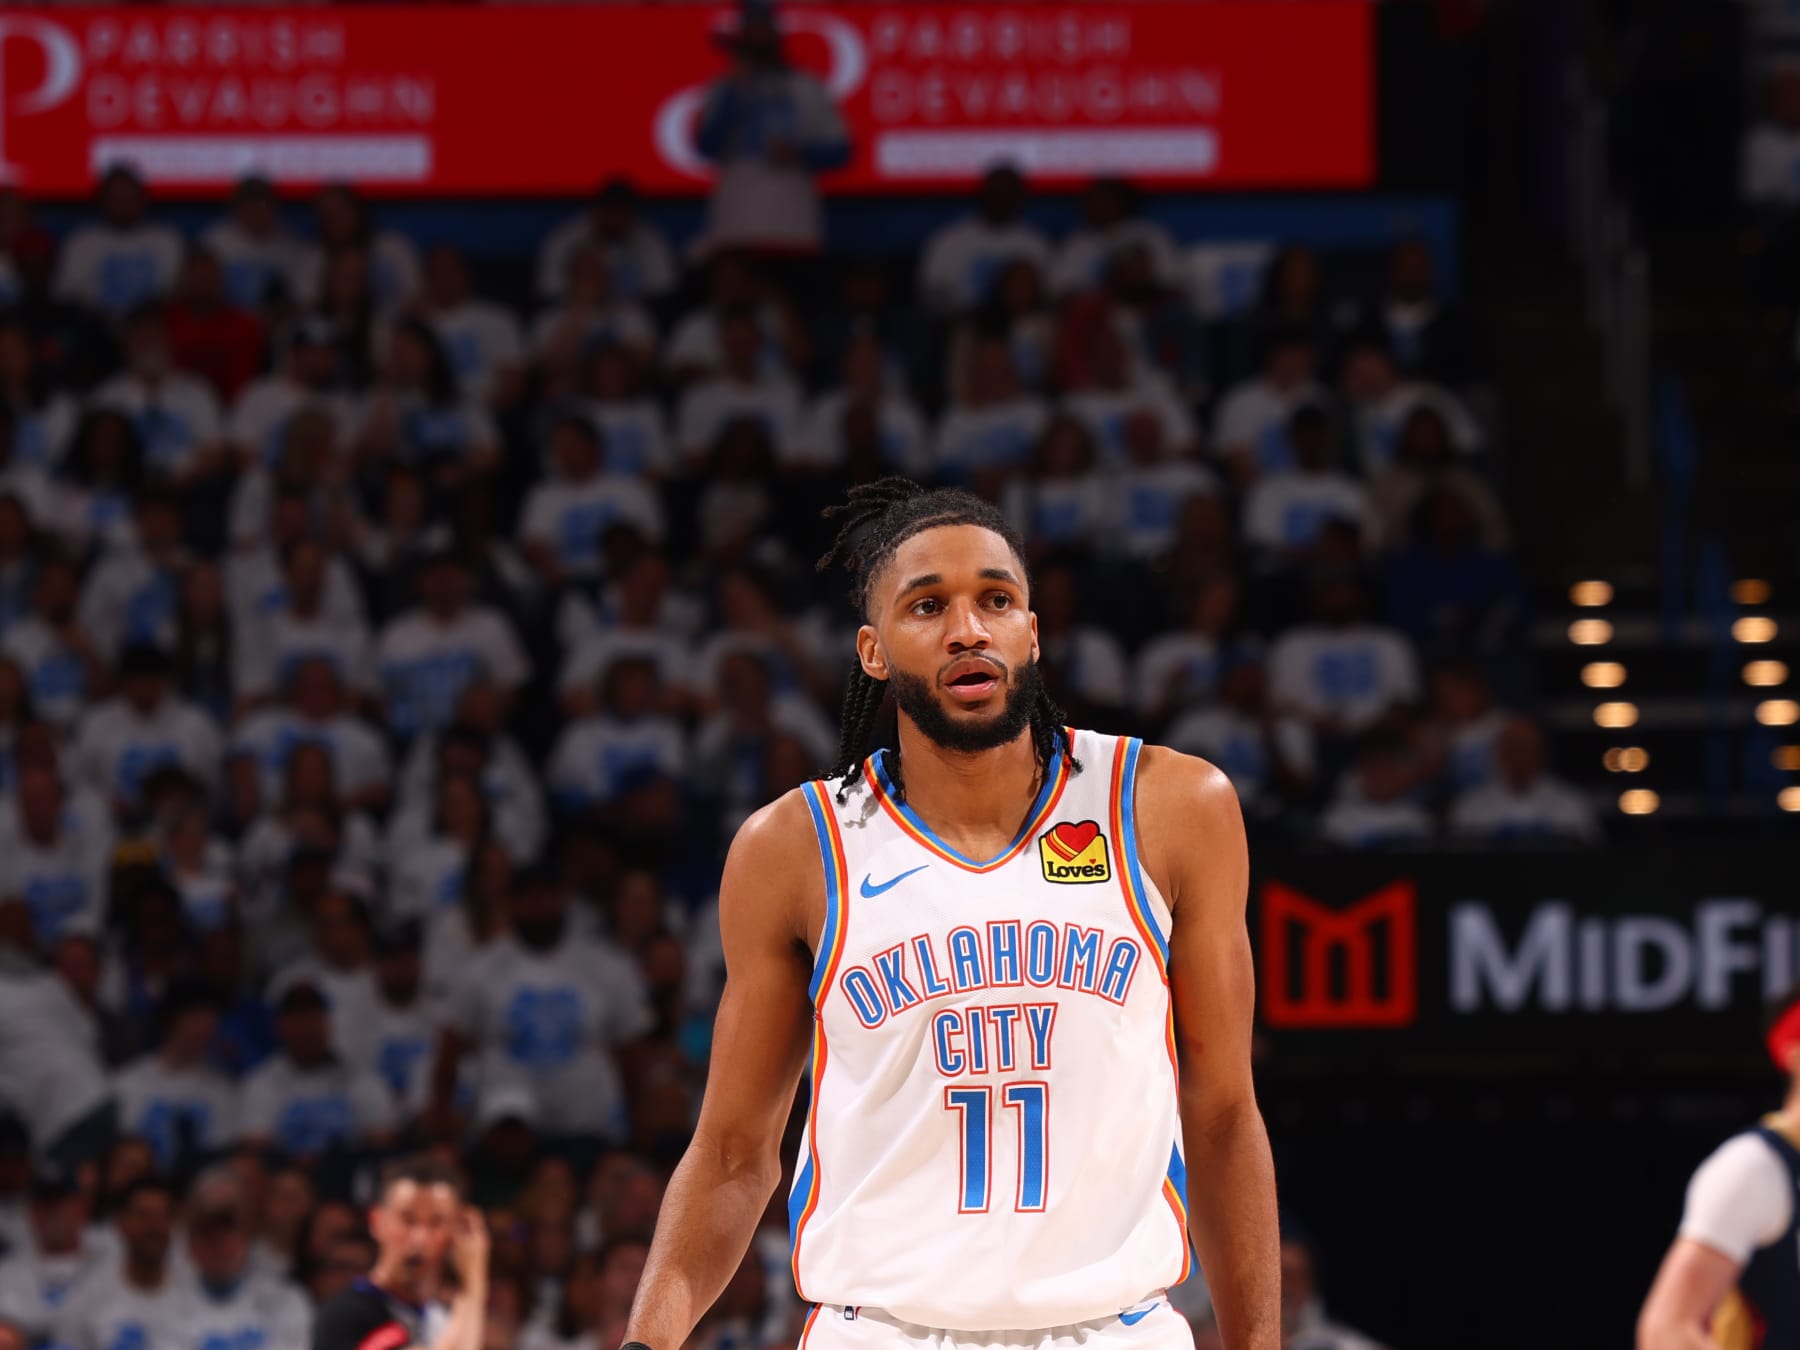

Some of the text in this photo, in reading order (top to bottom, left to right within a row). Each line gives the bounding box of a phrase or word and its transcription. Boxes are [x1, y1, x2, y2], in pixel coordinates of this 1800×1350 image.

[88, 17, 344, 64] PARRISH
[874, 15, 1130, 60] PARRISH
[87, 72, 435, 127] DEVAUGHN
[840, 919, 1141, 1029] OKLAHOMA
[932, 1002, 1058, 1077] CITY
[944, 1081, 1049, 1214] 11
